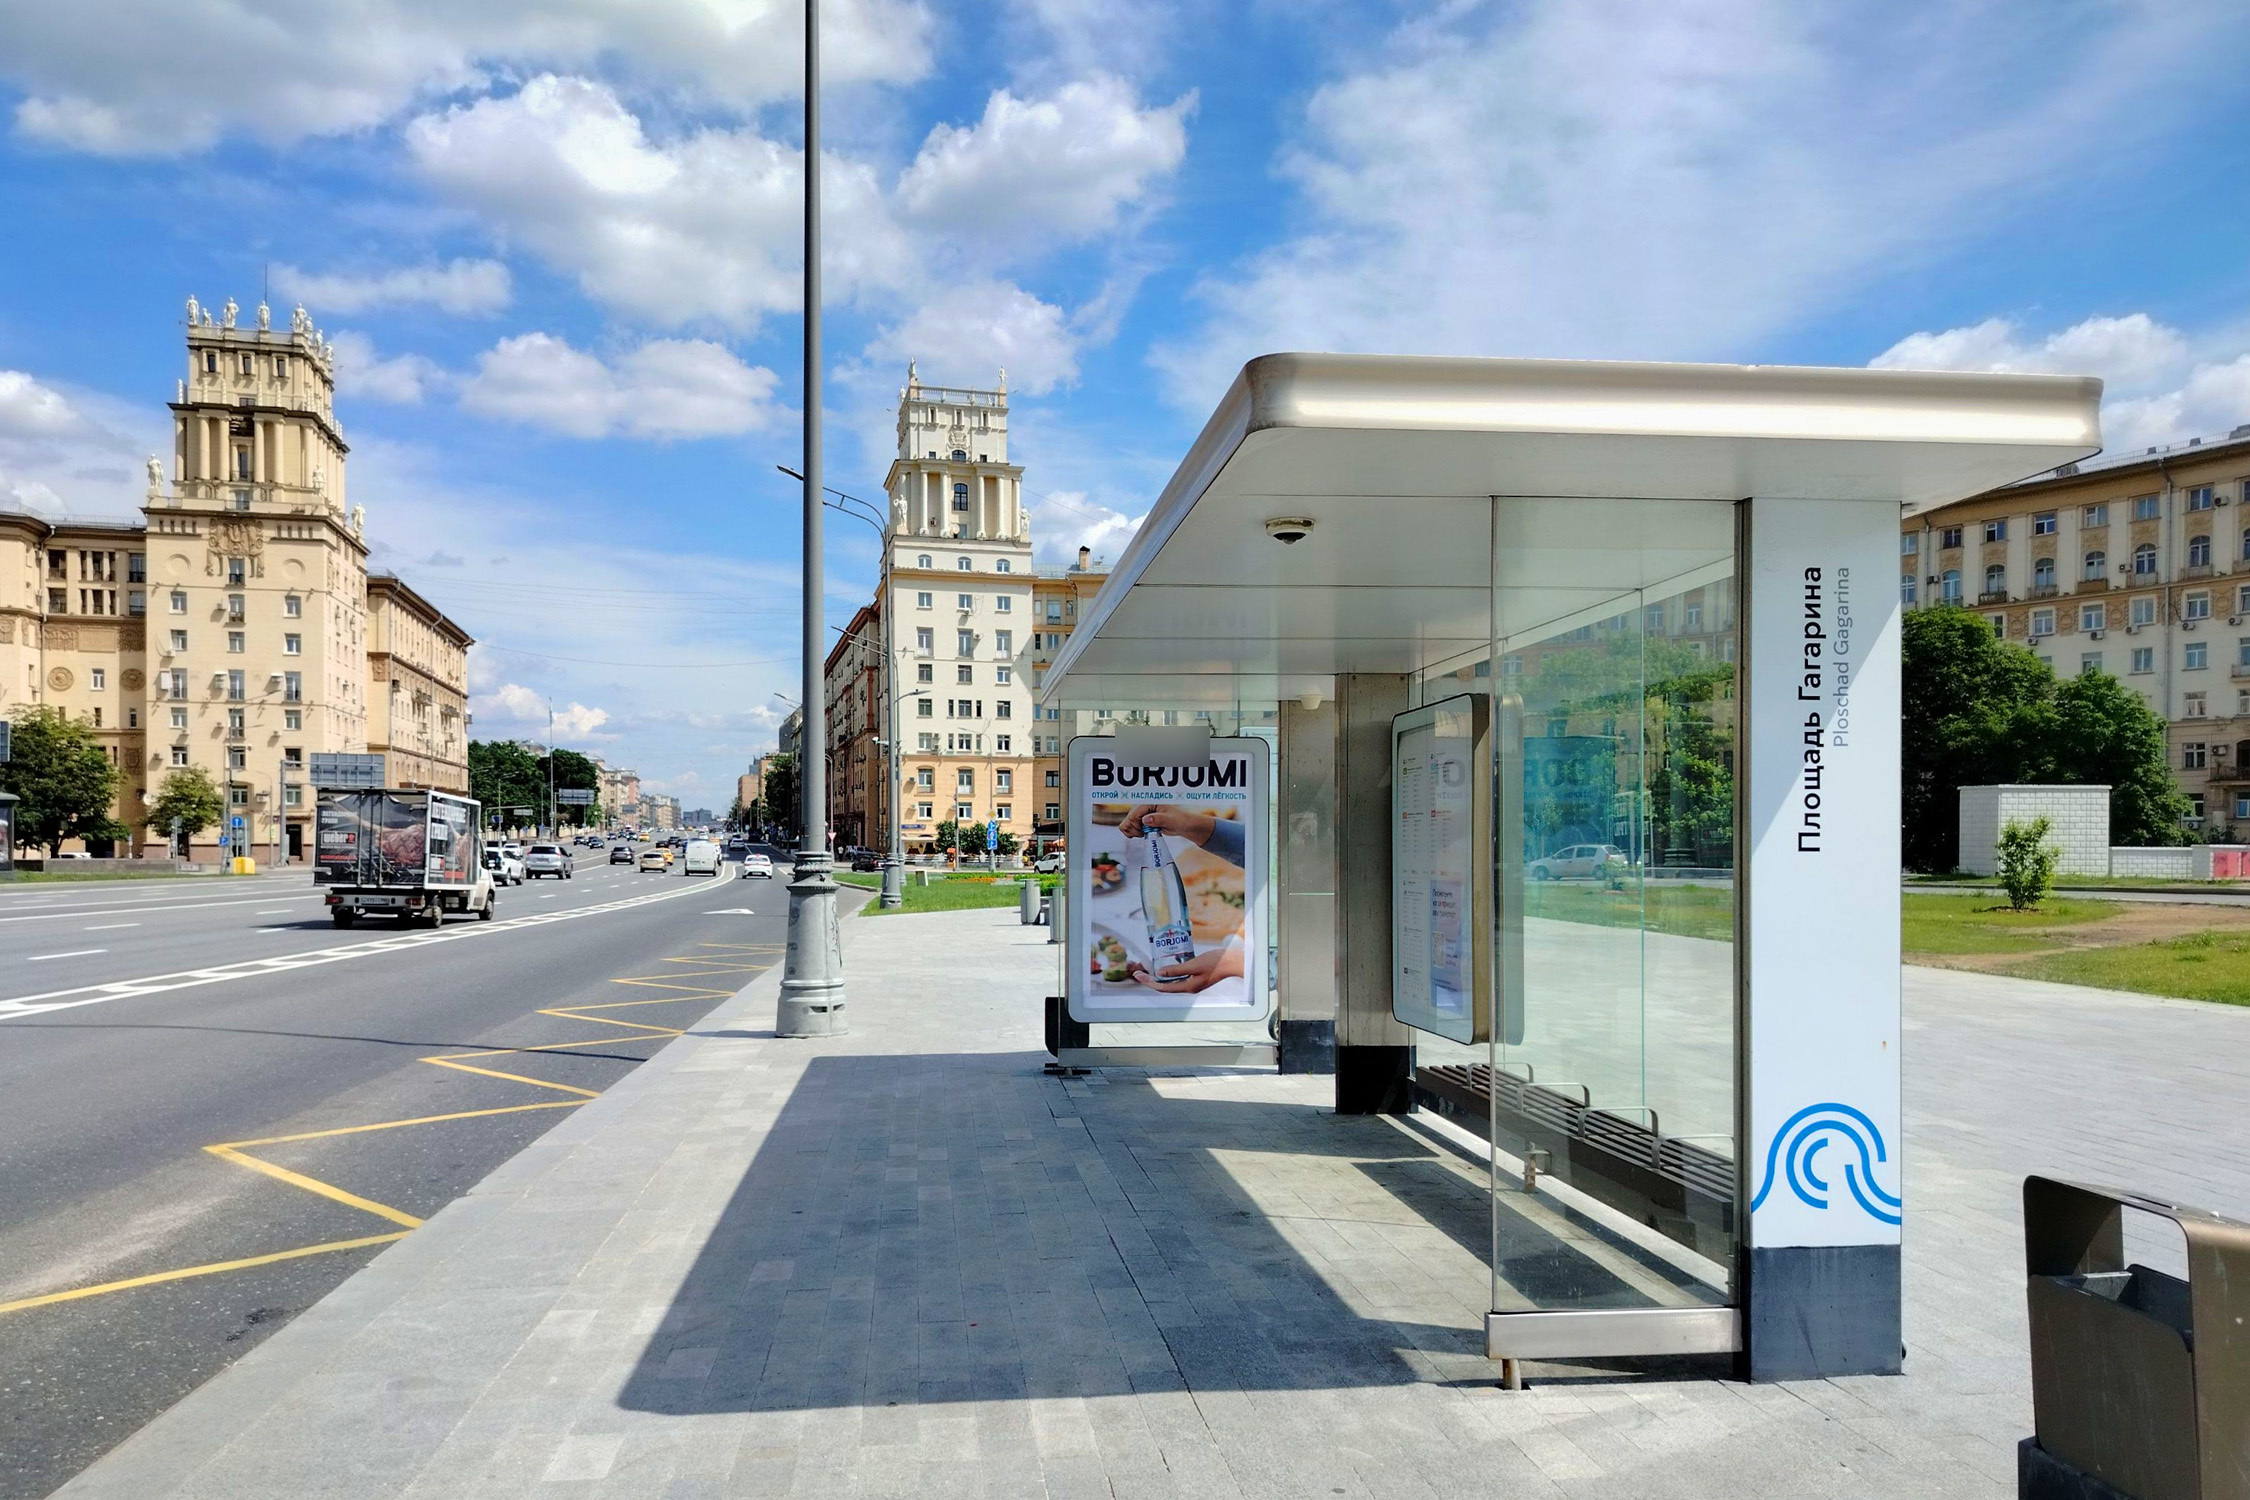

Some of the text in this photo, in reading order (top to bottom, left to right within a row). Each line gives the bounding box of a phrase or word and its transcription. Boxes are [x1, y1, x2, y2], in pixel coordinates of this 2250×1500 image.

[1833, 567, 1853, 747] Ploschad Gagarina
[1798, 566, 1826, 852] Площадь Гагарина
[1092, 791, 1247, 800] ОТКРОЙ НАСЛАДИСЬ ОЩУТИ ЛЁГКОСТЬ
[1152, 839, 1161, 867] BORJOMI
[1156, 935, 1189, 947] BORJOMI
